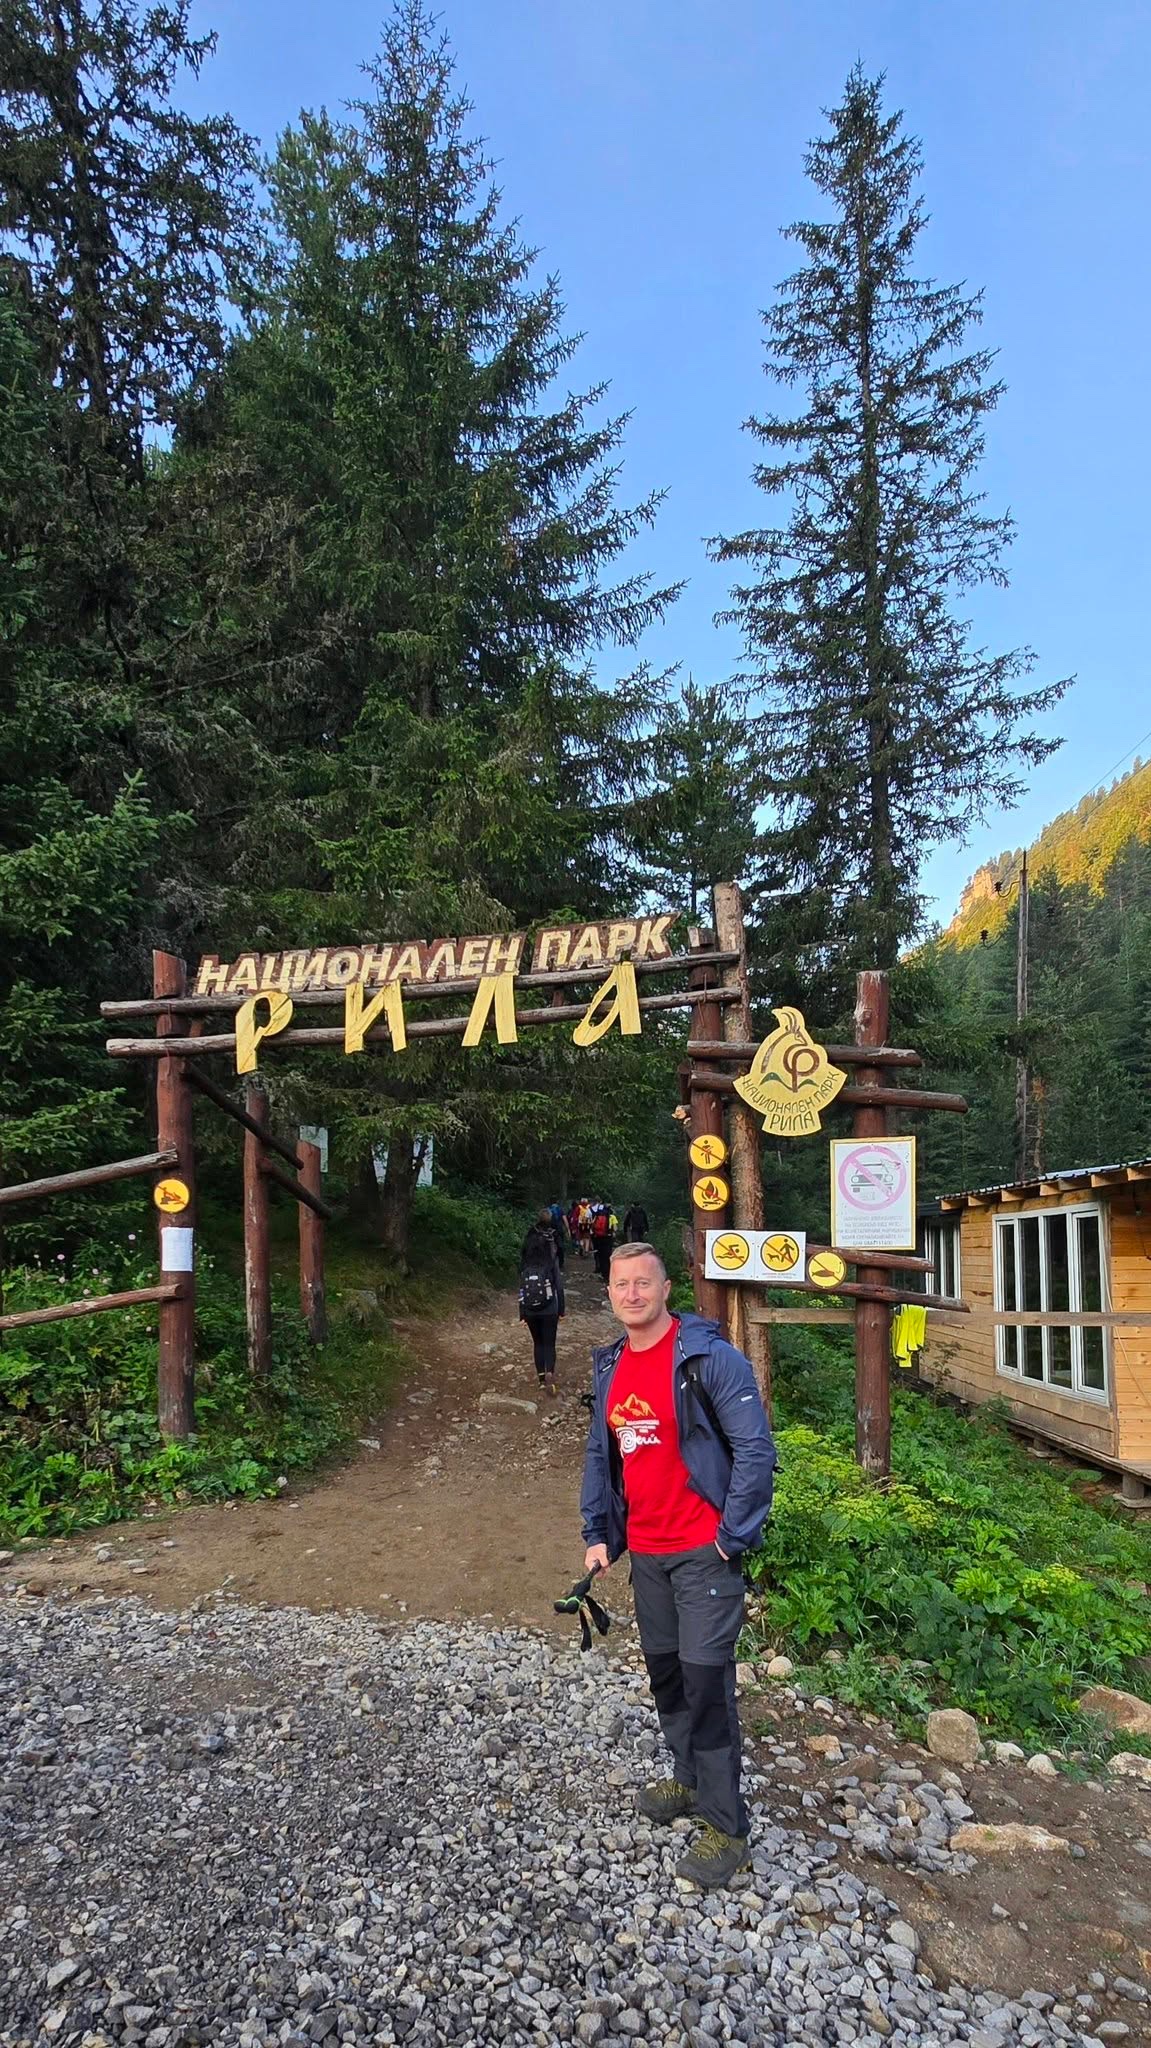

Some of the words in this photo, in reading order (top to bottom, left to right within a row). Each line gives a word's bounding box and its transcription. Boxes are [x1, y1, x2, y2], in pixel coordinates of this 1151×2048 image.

[197, 936, 522, 995] НАЦИОНАЛЕН
[536, 915, 673, 971] ПАРК
[235, 961, 643, 1075] РИЛА
[742, 1078, 815, 1114] НАЦИОНАЛЕН
[813, 1071, 840, 1103] ПАРК
[769, 1110, 816, 1132] РИЛА
